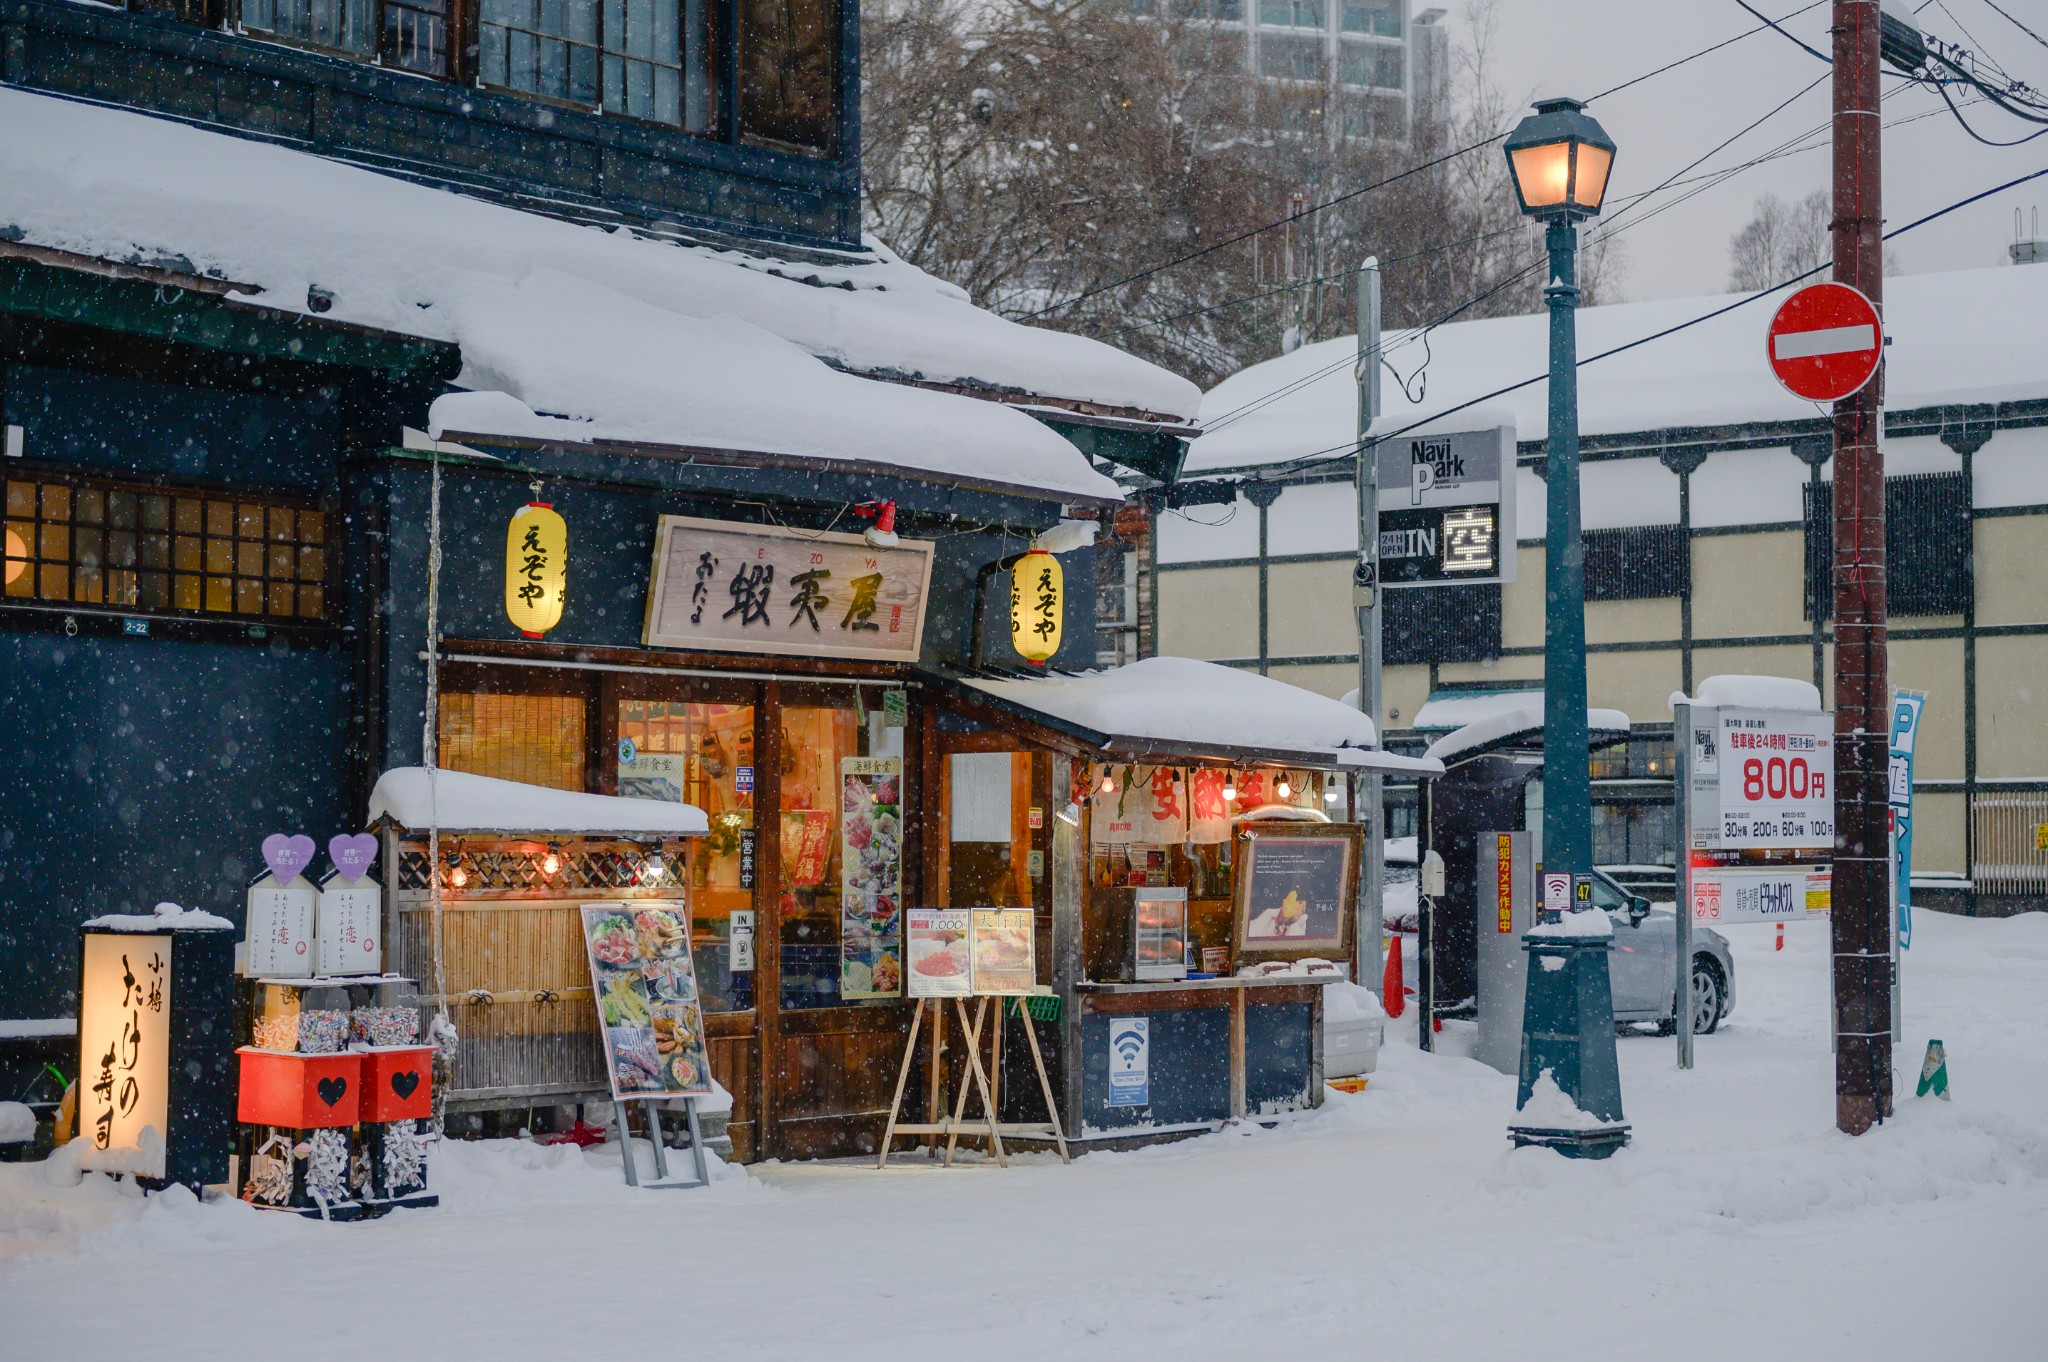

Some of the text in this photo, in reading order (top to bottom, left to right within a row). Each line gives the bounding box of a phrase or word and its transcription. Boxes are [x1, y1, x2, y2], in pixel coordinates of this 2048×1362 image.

[1412, 439, 1465, 505] Navi Park
[1382, 534, 1403, 544] 24H
[1406, 528, 1436, 558] IN
[1446, 511, 1492, 569] 空
[758, 548, 878, 569] E ZO YA
[1382, 545, 1403, 556] OPEN
[518, 525, 548, 608] えぞや
[1033, 568, 1056, 642] えぞや
[126, 622, 146, 632] 2-22
[1732, 732, 1786, 750] 駐車後24時間
[854, 760, 892, 773] 海鮮食堂
[1744, 757, 1825, 800] 800円
[1753, 822, 1778, 837] 200円
[1810, 820, 1832, 836] 100円
[742, 840, 754, 887] 営業中
[1500, 836, 1510, 932] 防犯カメラ作動中
[1578, 884, 1590, 900] 47
[738, 915, 747, 924] IN
[980, 914, 1025, 929] 大将丼
[146, 952, 164, 1013] 小樽
[119, 954, 144, 1118] たけの
